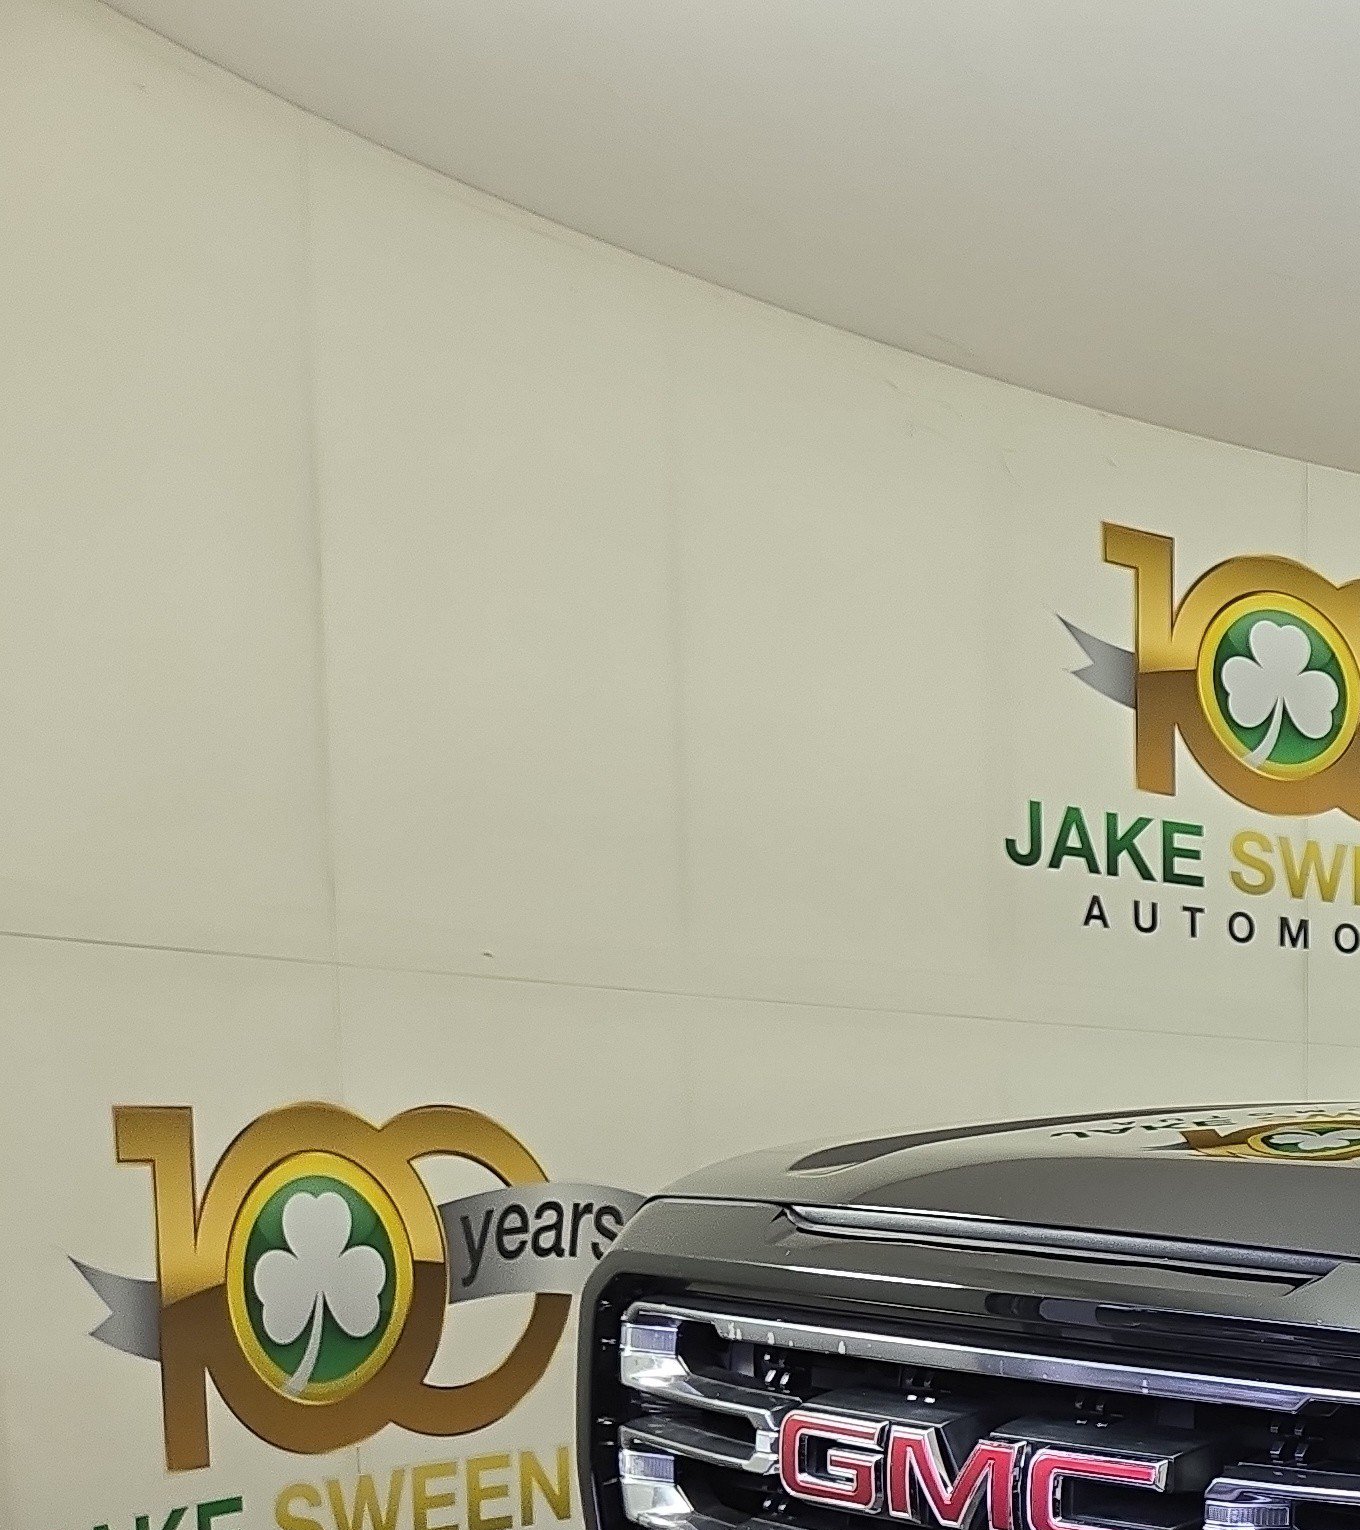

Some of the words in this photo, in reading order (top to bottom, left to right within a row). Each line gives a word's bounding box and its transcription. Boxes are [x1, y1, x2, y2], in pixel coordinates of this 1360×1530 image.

[1004, 800, 1205, 888] JAKE
[460, 1200, 623, 1286] years
[112, 1101, 572, 1474] 100
